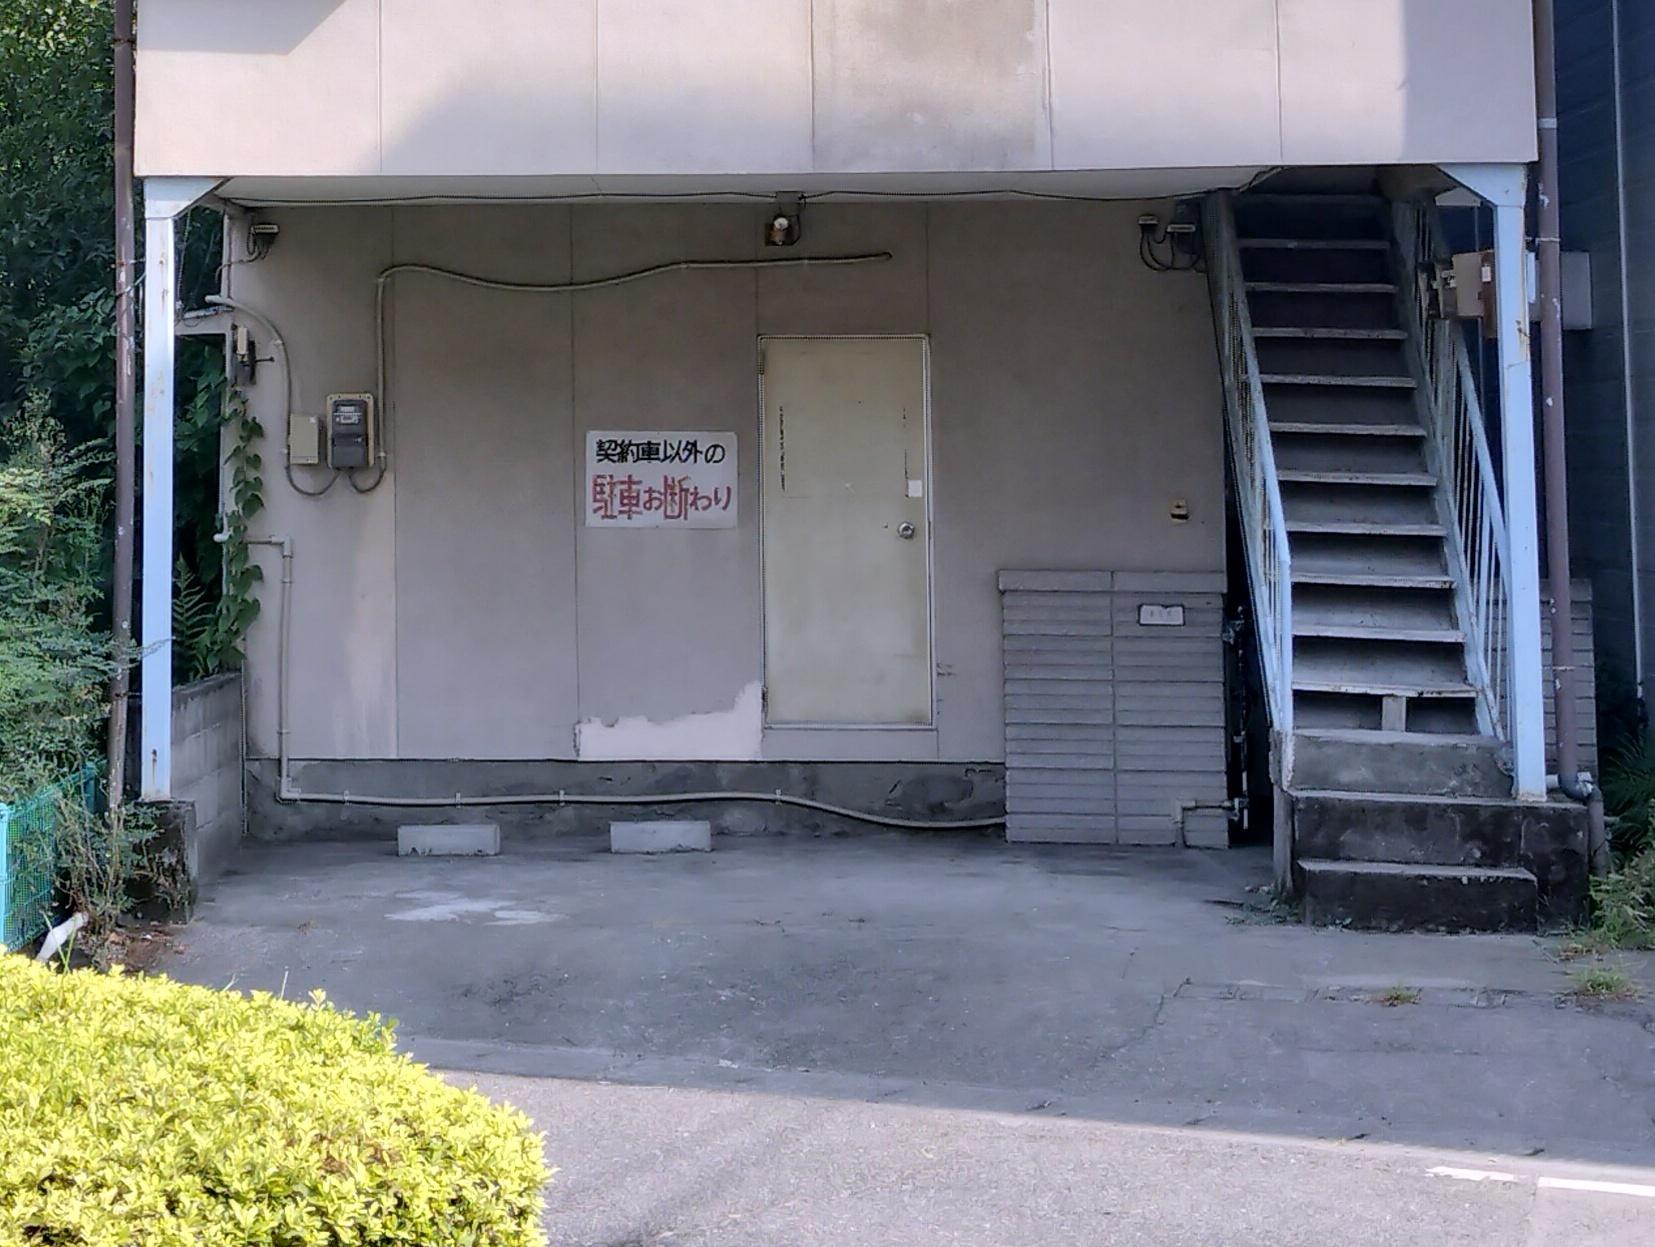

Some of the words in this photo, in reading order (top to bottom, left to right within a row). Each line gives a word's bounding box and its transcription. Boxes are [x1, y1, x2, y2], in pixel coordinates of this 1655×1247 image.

[596, 439, 726, 464] 契約車以外の
[592, 474, 732, 520] 駐車お断わり
